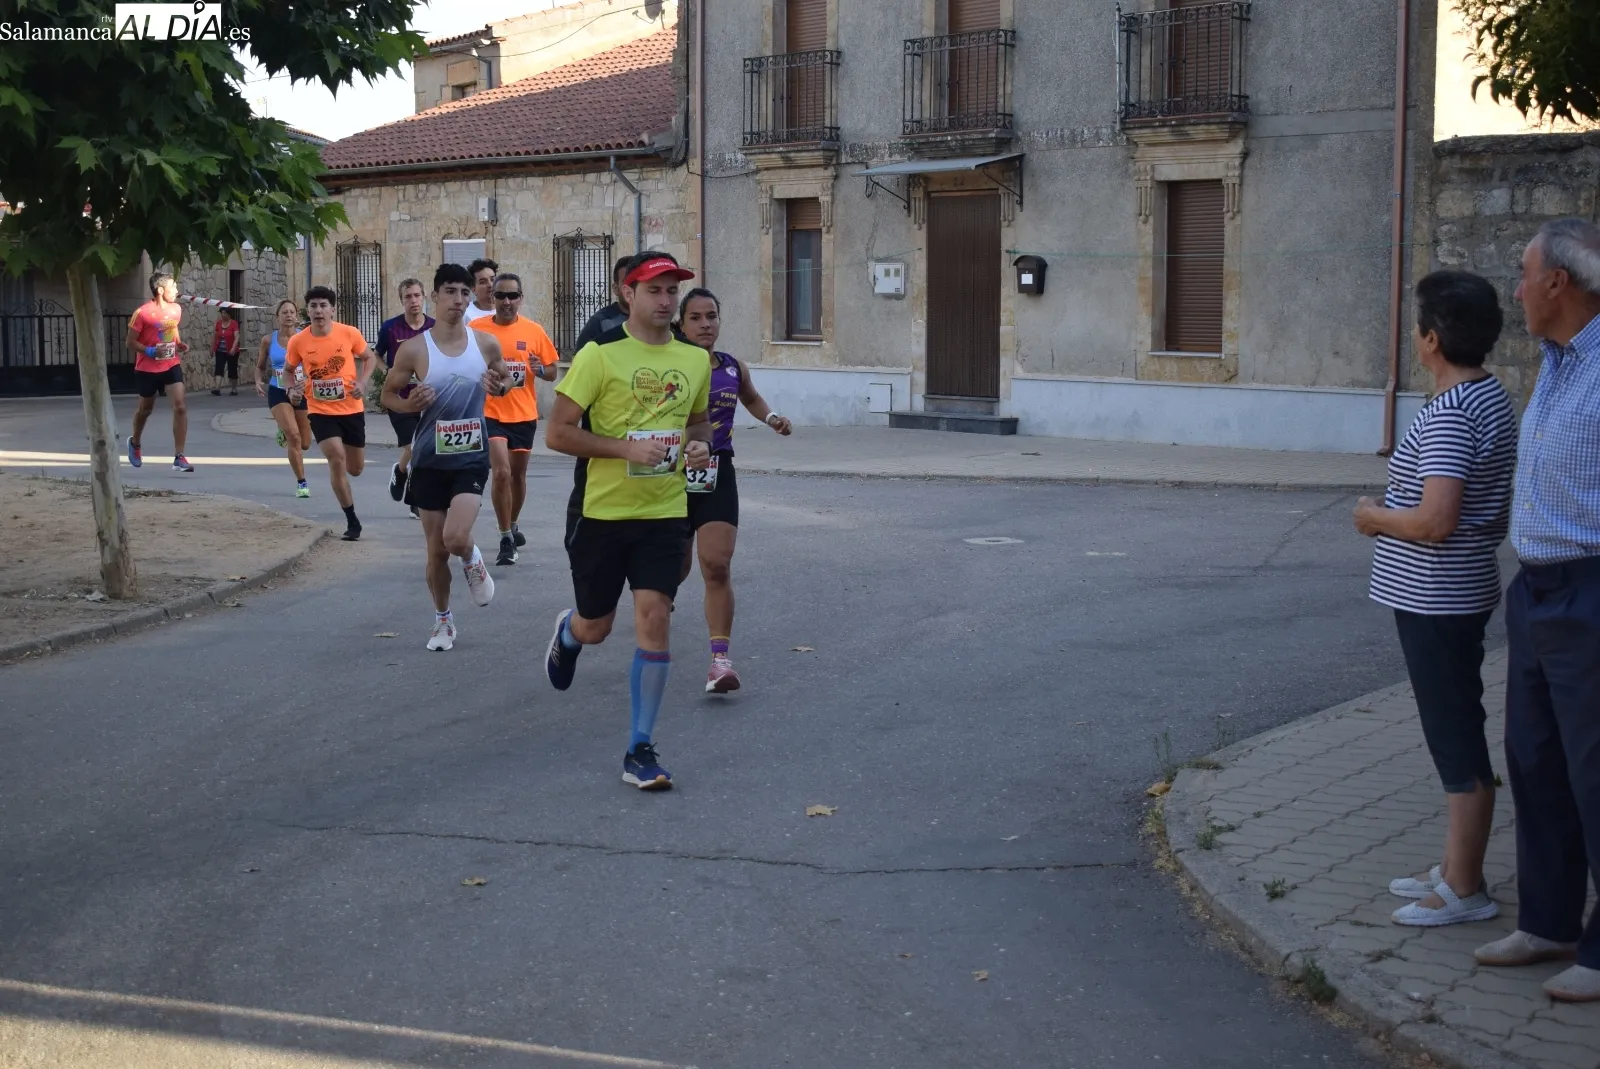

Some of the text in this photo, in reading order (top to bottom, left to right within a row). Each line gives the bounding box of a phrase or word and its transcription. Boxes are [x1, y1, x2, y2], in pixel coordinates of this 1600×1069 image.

[313, 380, 343, 388] bedunia
[319, 387, 338, 396] 221
[437, 421, 480, 433] bedunia
[444, 431, 472, 446] 227
[687, 469, 708, 483] 32
